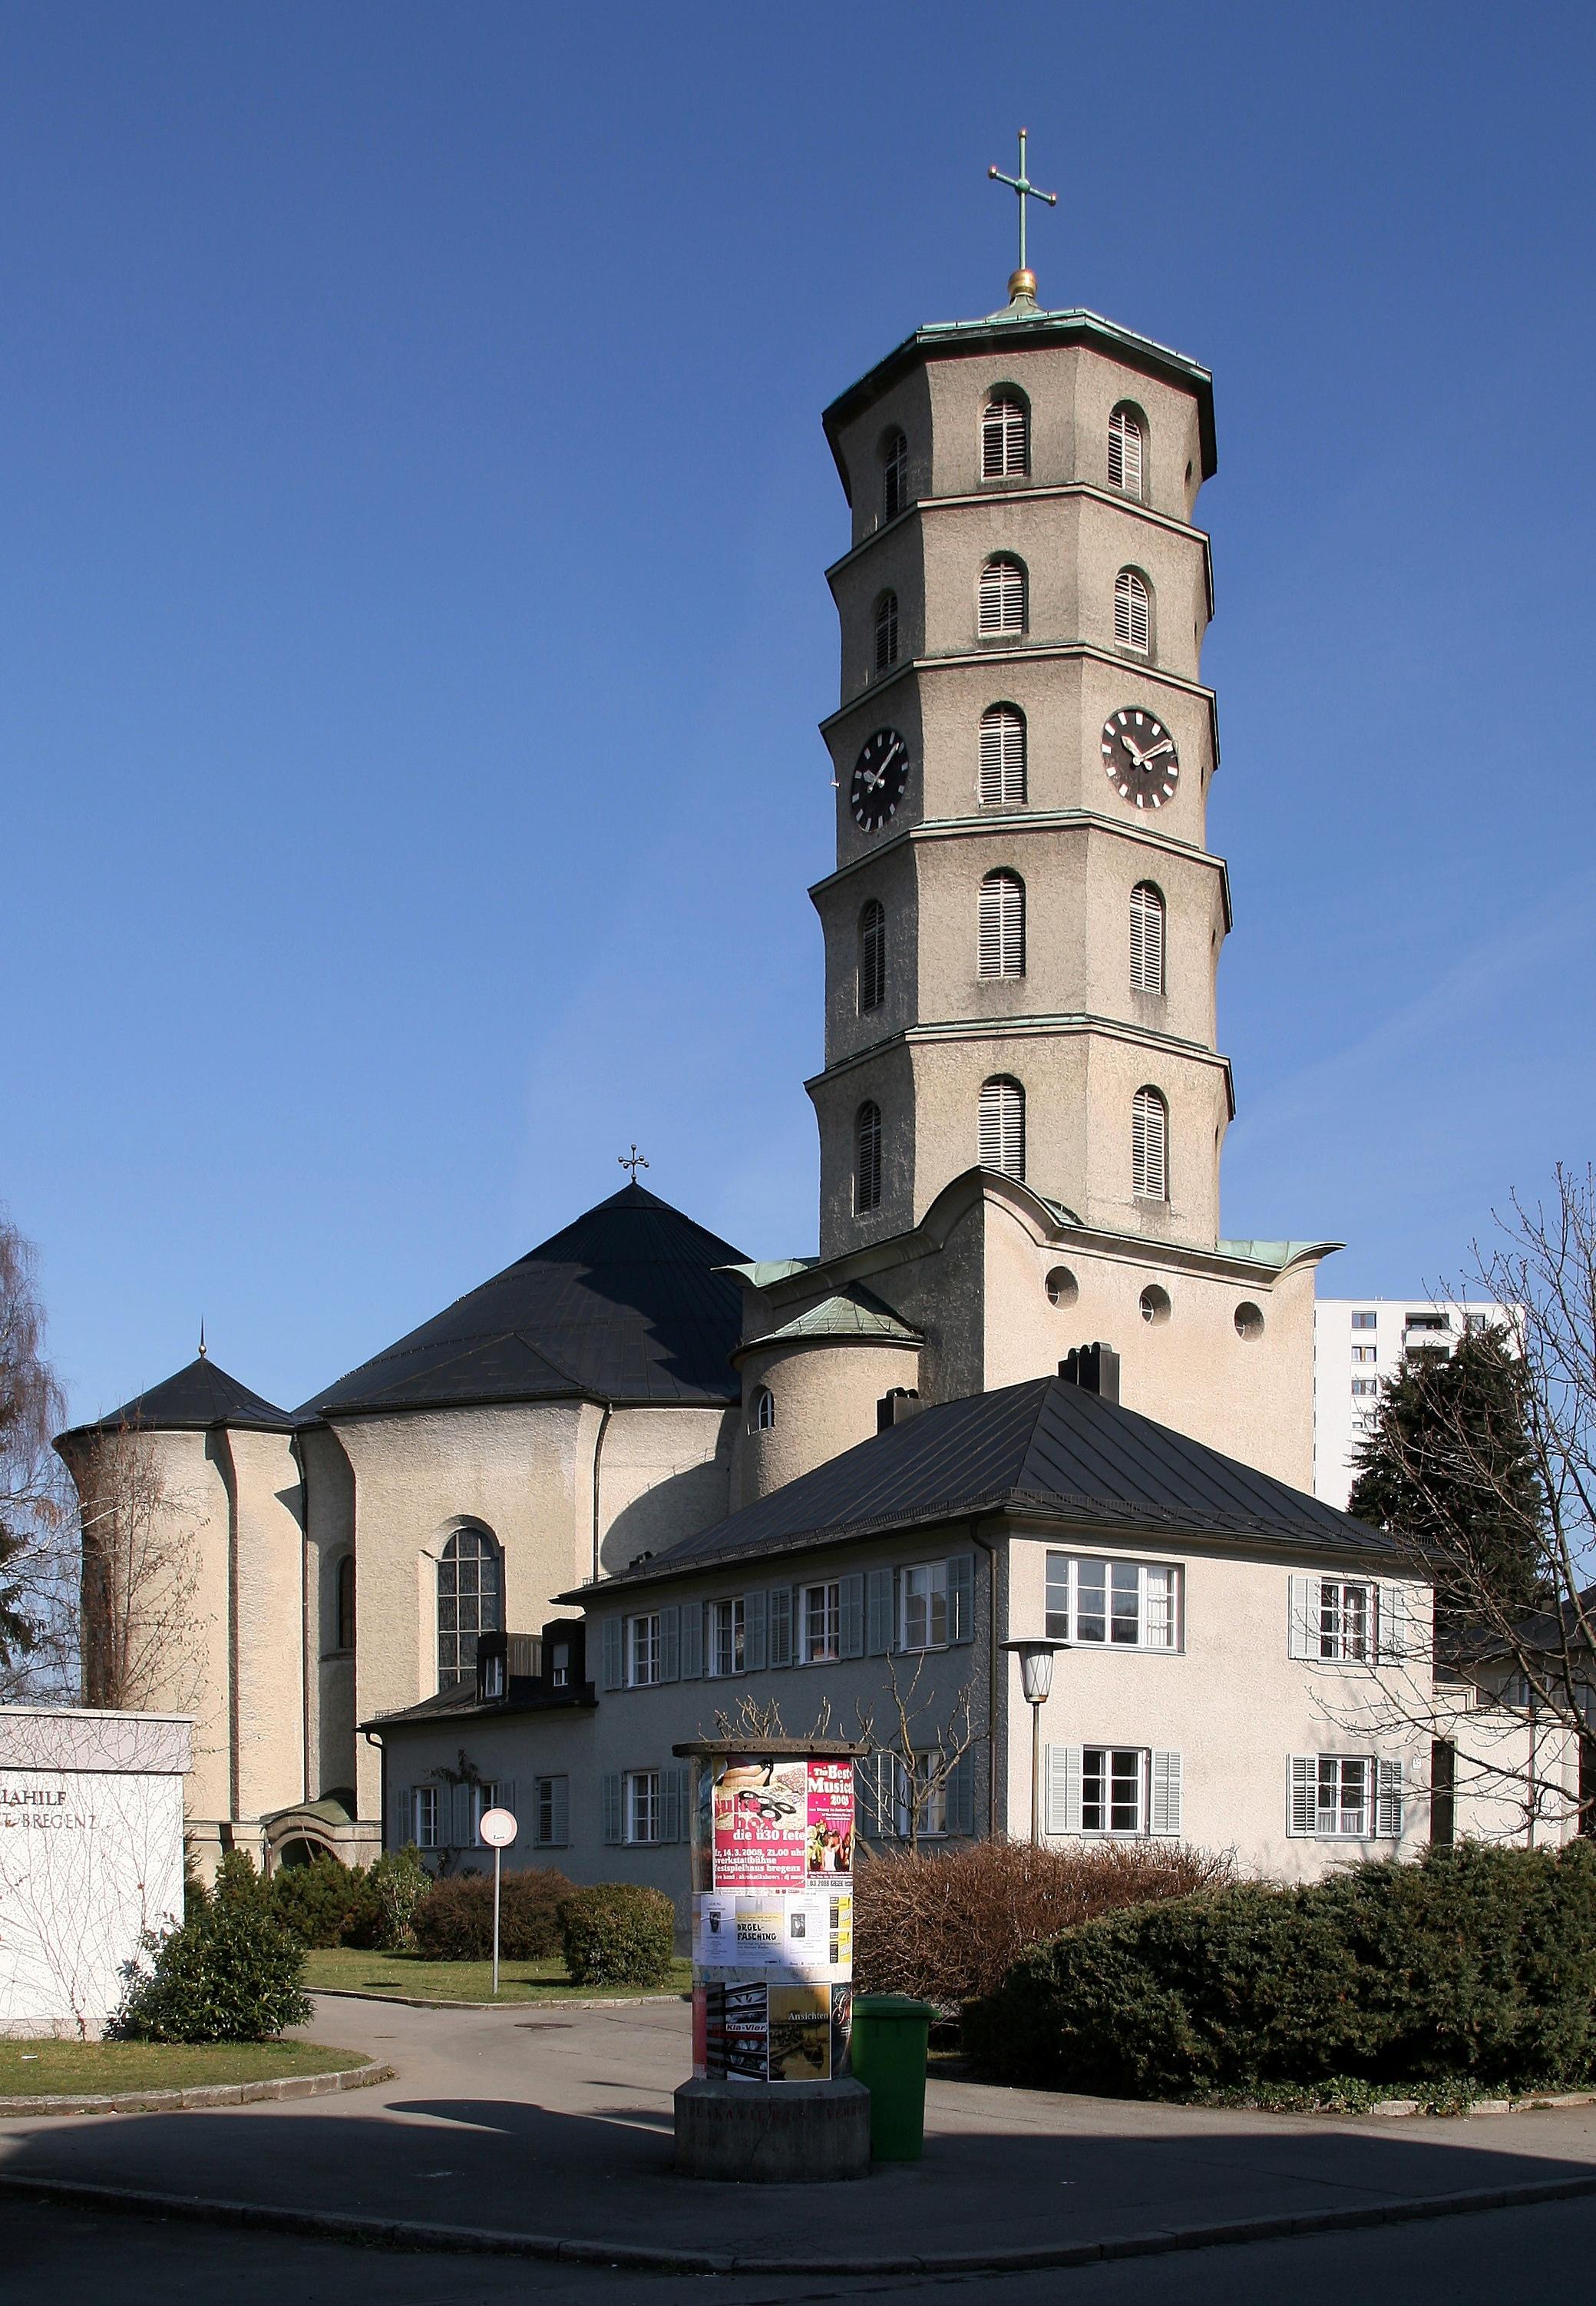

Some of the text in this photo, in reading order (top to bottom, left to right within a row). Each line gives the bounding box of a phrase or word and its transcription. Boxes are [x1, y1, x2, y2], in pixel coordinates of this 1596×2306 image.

[828, 1765, 851, 1780] Best
[0, 1789, 67, 1806] IAHILF
[830, 1793, 849, 1806] 2008
[22, 1813, 98, 1830] BREGENZ
[732, 1828, 752, 1841] die
[755, 1828, 780, 1841] ü30
[766, 1864, 801, 1874] bregenz
[737, 1924, 765, 1932] ORGEL-
[737, 1932, 777, 1941] FASCHING
[788, 2012, 829, 2021] Ansichten
